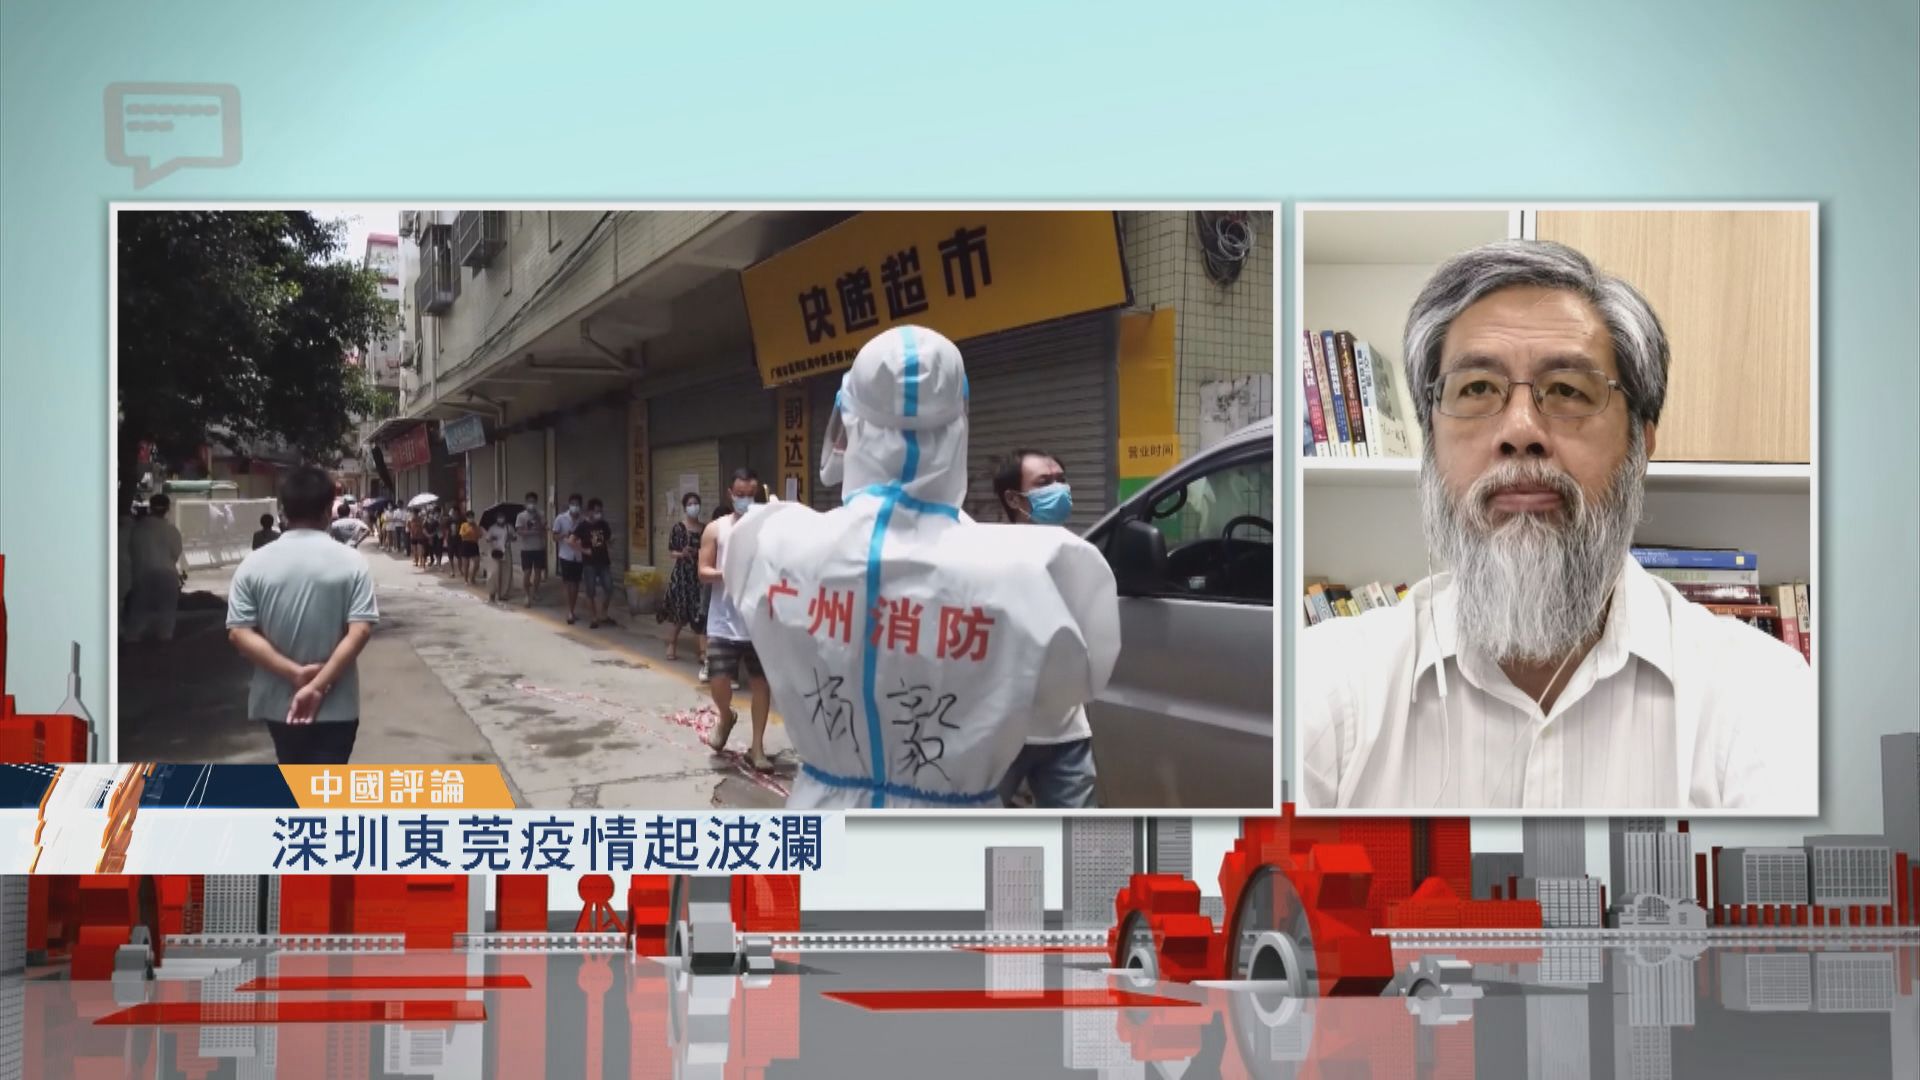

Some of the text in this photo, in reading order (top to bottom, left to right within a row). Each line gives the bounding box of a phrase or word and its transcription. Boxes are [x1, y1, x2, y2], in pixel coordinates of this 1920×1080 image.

[798, 224, 993, 344] 快递超市
[1127, 443, 1174, 459] 营业时间
[766, 578, 995, 662] 广州消防
